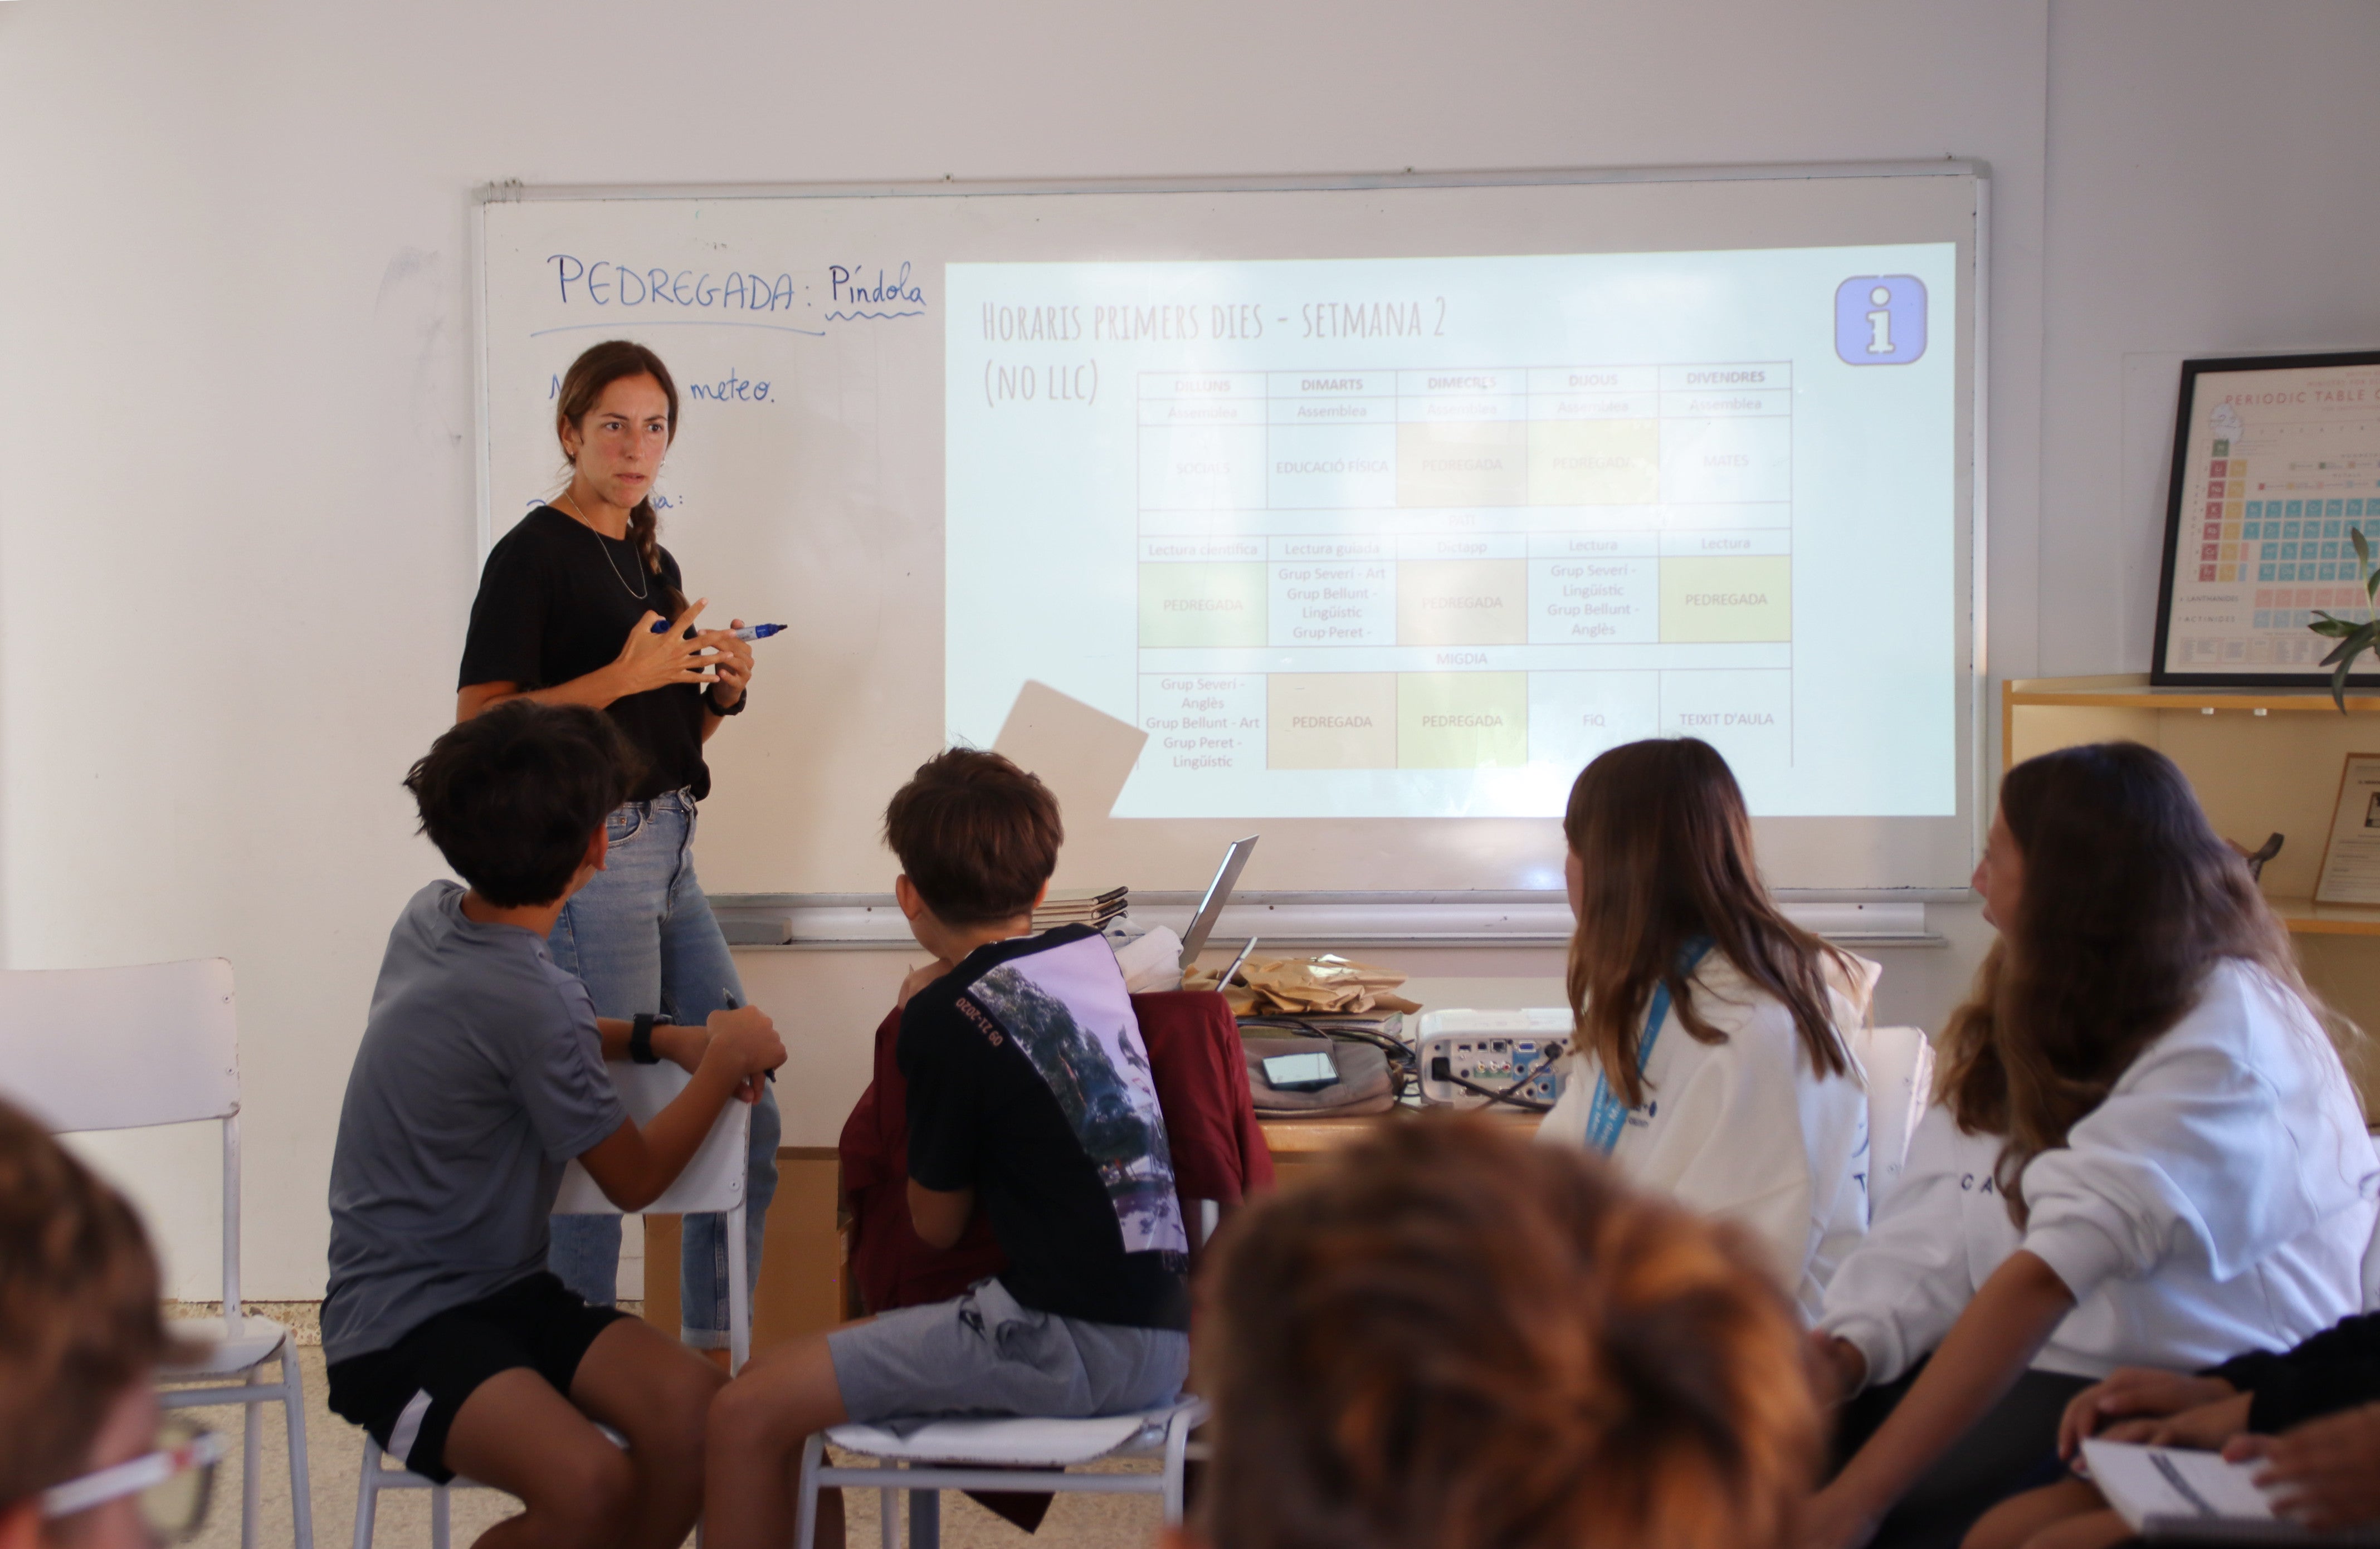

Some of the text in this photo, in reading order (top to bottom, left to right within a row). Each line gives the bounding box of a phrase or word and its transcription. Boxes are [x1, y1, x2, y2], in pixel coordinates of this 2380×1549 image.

[829, 261, 926, 306] Píndola
[1211, 304, 1262, 339] DIES
[1303, 301, 1421, 338] SETMANA
[1433, 296, 1447, 336] 2
[985, 358, 1098, 408] (NO LLC)
[1428, 376, 1497, 389] DIMECRES
[1569, 374, 1618, 387] DIJOUS
[1687, 370, 1766, 384] DIVENDRES
[691, 368, 776, 403] meteo.
[1175, 380, 1231, 392] DILLUNS
[1301, 378, 1363, 391] DIMARTS
[2224, 392, 2306, 405] PERIODIC
[2315, 389, 2366, 402] TABLE
[1168, 405, 1237, 418] Assemblea
[1298, 405, 1367, 418] Assemblea
[1427, 403, 1497, 416] Assemblea
[1557, 401, 1628, 413] Assemblea
[1690, 398, 1762, 411] Assemblea
[1276, 457, 1388, 474] EDUCACIÓ FÍSICA
[1422, 458, 1503, 472] PEDREGADA
[1704, 454, 1749, 467] MATES
[1149, 543, 1196, 556] Lectura
[1285, 543, 1380, 558] Lectura guiada
[1437, 541, 1488, 556] Dictapp
[1569, 539, 1618, 551] Lectura
[1701, 538, 1751, 550] Lectura
[1279, 569, 1311, 583] Grup
[1314, 566, 1354, 580] Severí
[1366, 568, 1386, 579] Art
[1550, 564, 1583, 579] Grup
[1587, 562, 1628, 576] Severí
[1287, 588, 1320, 602] Grup
[1323, 588, 1369, 600] Bellunt
[1563, 583, 1625, 599] Lingüístic
[1163, 599, 1243, 612] PEDREGADA
[1422, 596, 1504, 609] PEDREGADA
[1685, 593, 1768, 606] PEDREGADA
[1302, 605, 1362, 620] Lingüístic
[1547, 603, 1581, 618] Grup
[1584, 603, 1631, 615] Bellunt
[1293, 627, 1326, 641] Grup
[1329, 627, 1363, 638] Peret
[1571, 622, 1616, 638] Anglès
[1437, 653, 1488, 665] MIGDIA
[1161, 679, 1193, 693] Grup
[1197, 677, 1237, 690] Severí
[1181, 697, 1225, 711] Anglès
[1146, 717, 1179, 731] Grup
[1182, 716, 1227, 729] Bellunt
[1239, 717, 1260, 729] Art
[1292, 715, 1373, 728] PEDREGADA
[1422, 715, 1504, 727] PEDREGADA
[1680, 712, 1774, 725] TEIXIT D'AULA
[1163, 737, 1196, 751] Grup
[1199, 737, 1234, 749] Peret
[1173, 754, 1233, 770] Lingüístic
